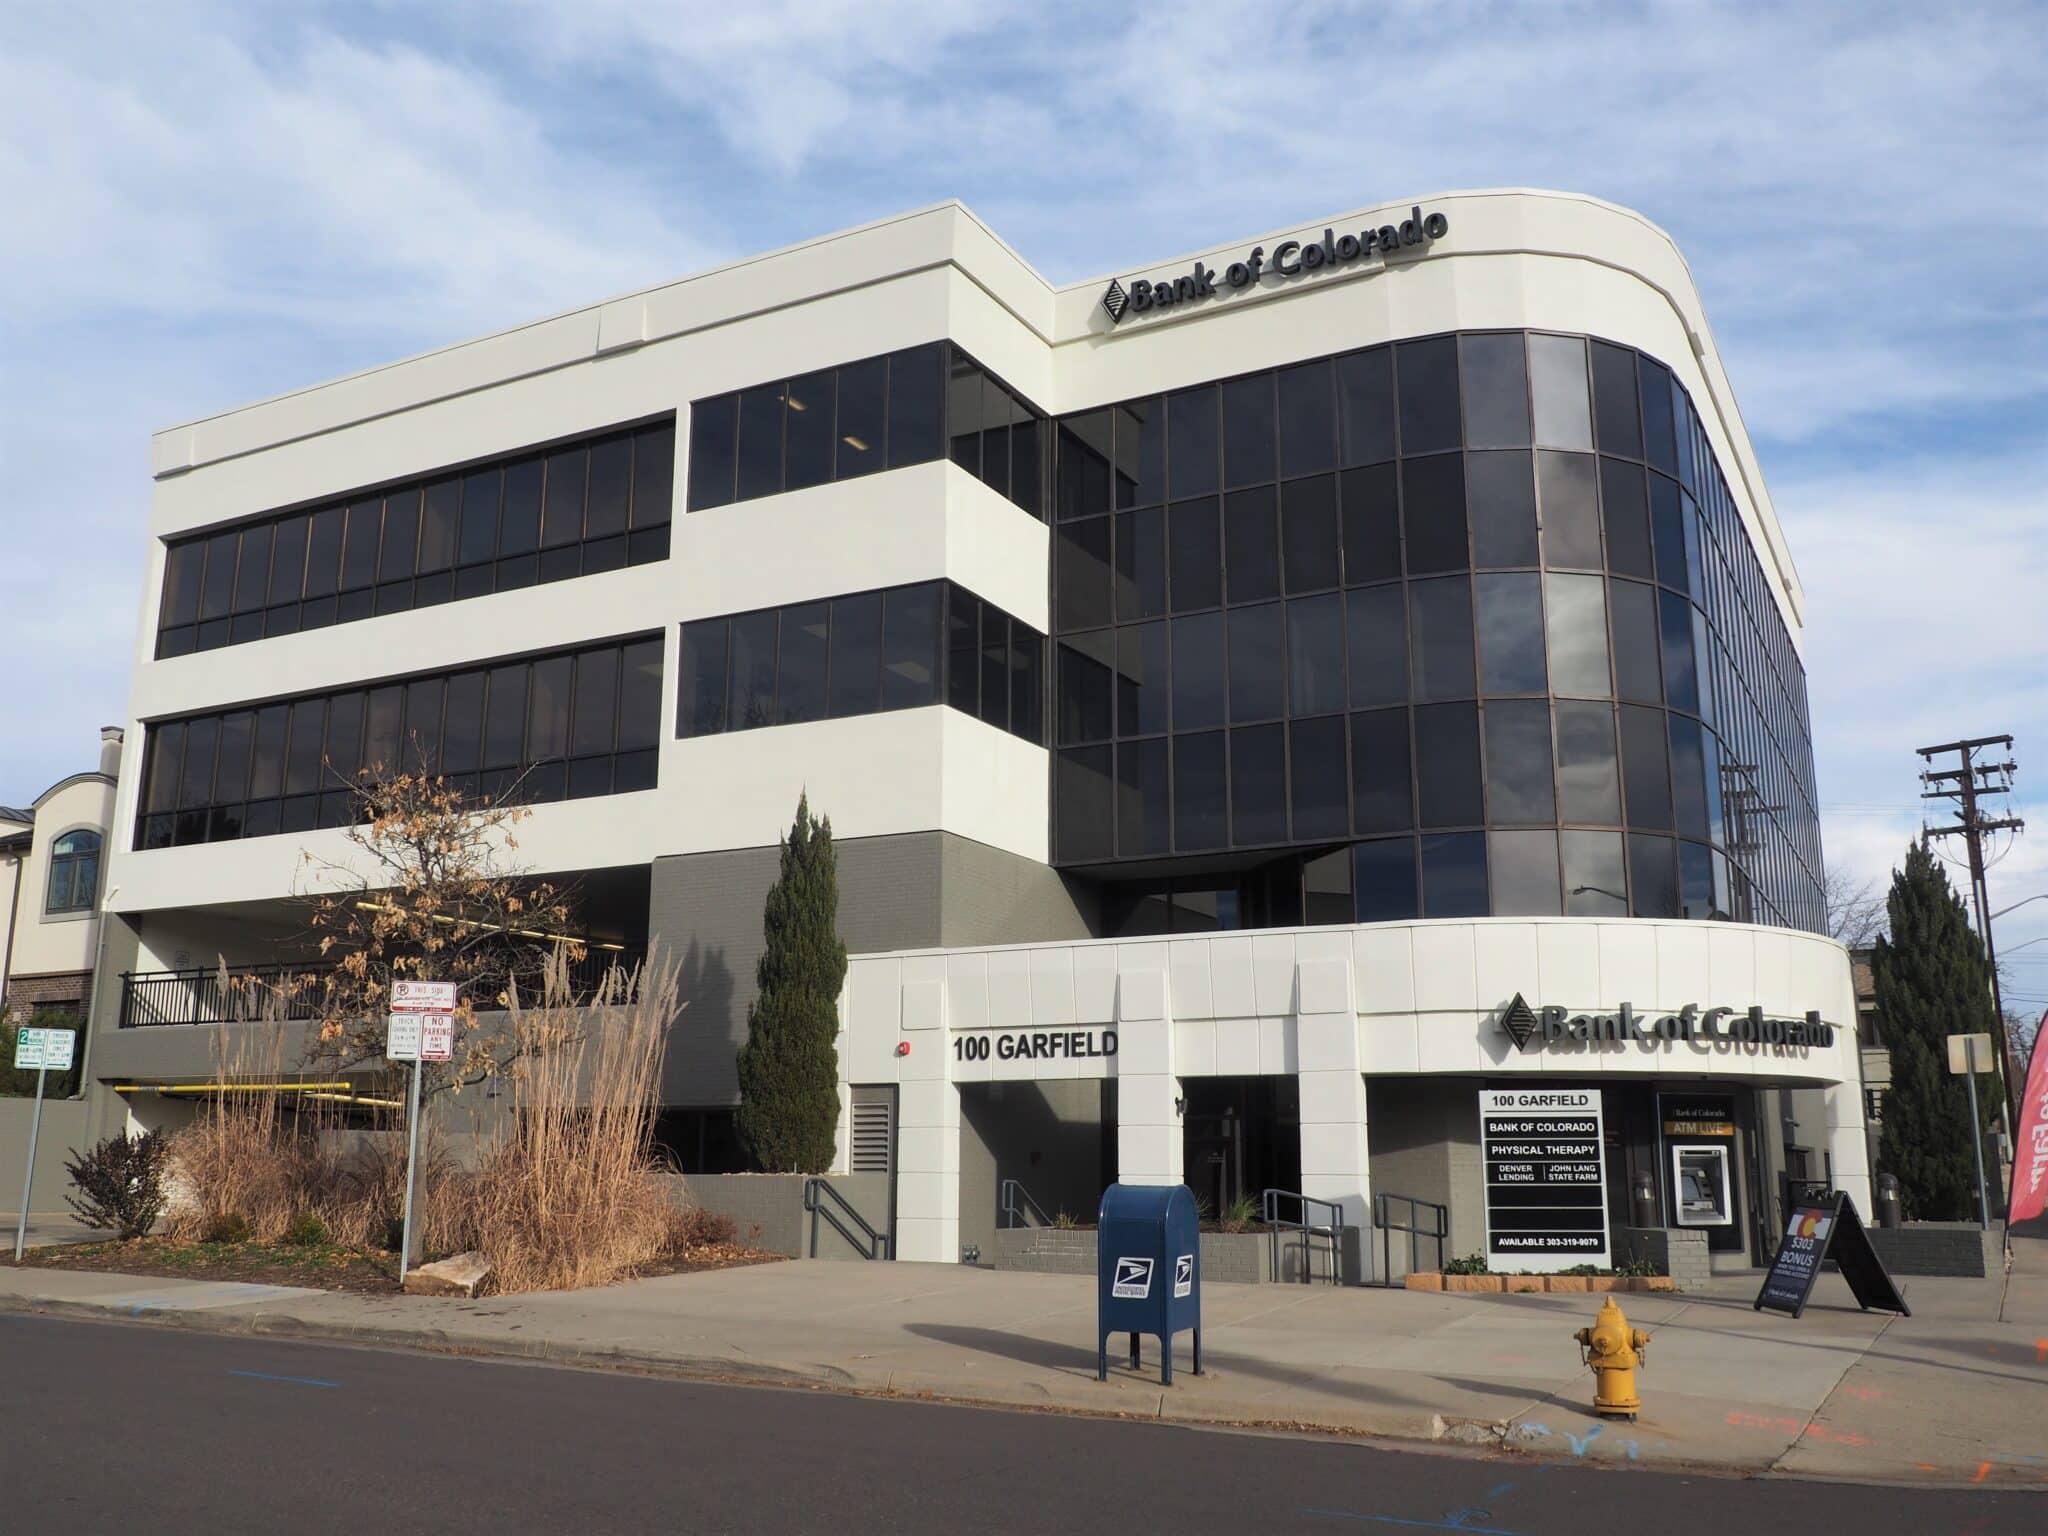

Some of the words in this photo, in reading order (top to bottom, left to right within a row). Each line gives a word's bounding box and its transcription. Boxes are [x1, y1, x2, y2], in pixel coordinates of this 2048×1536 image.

[1130, 262, 1216, 312] Bank
[1226, 246, 1263, 288] of
[1272, 206, 1448, 275] Colorado
[432, 1017, 443, 1026] NO
[1543, 1002, 1647, 1041] Bank
[1657, 1003, 1698, 1041] of
[1703, 1006, 1834, 1048] Colorado
[20, 1031, 28, 1043] 2
[424, 1028, 451, 1037] PARKING
[953, 1036, 990, 1061] 100
[997, 1031, 1118, 1060] GARFIELD
[1492, 1095, 1514, 1106] 100
[1518, 1095, 1589, 1106] GARFIELD
[1490, 1123, 1519, 1132] BANK
[1520, 1123, 1534, 1132] OF
[1536, 1122, 1595, 1132] COLORADO
[1674, 1122, 1697, 1134] ATM
[1700, 1122, 1724, 1134] LIVE
[1491, 1146, 1544, 1155] PHYSICAL
[1546, 1146, 1595, 1155] THERAPY
[1498, 1173, 1535, 1181] LENDING
[1548, 1173, 1573, 1181] STATE
[1575, 1173, 1598, 1181] FARM
[1498, 1238, 1545, 1246] AVAILABLE
[1780, 1251, 1814, 1266] BONUS
